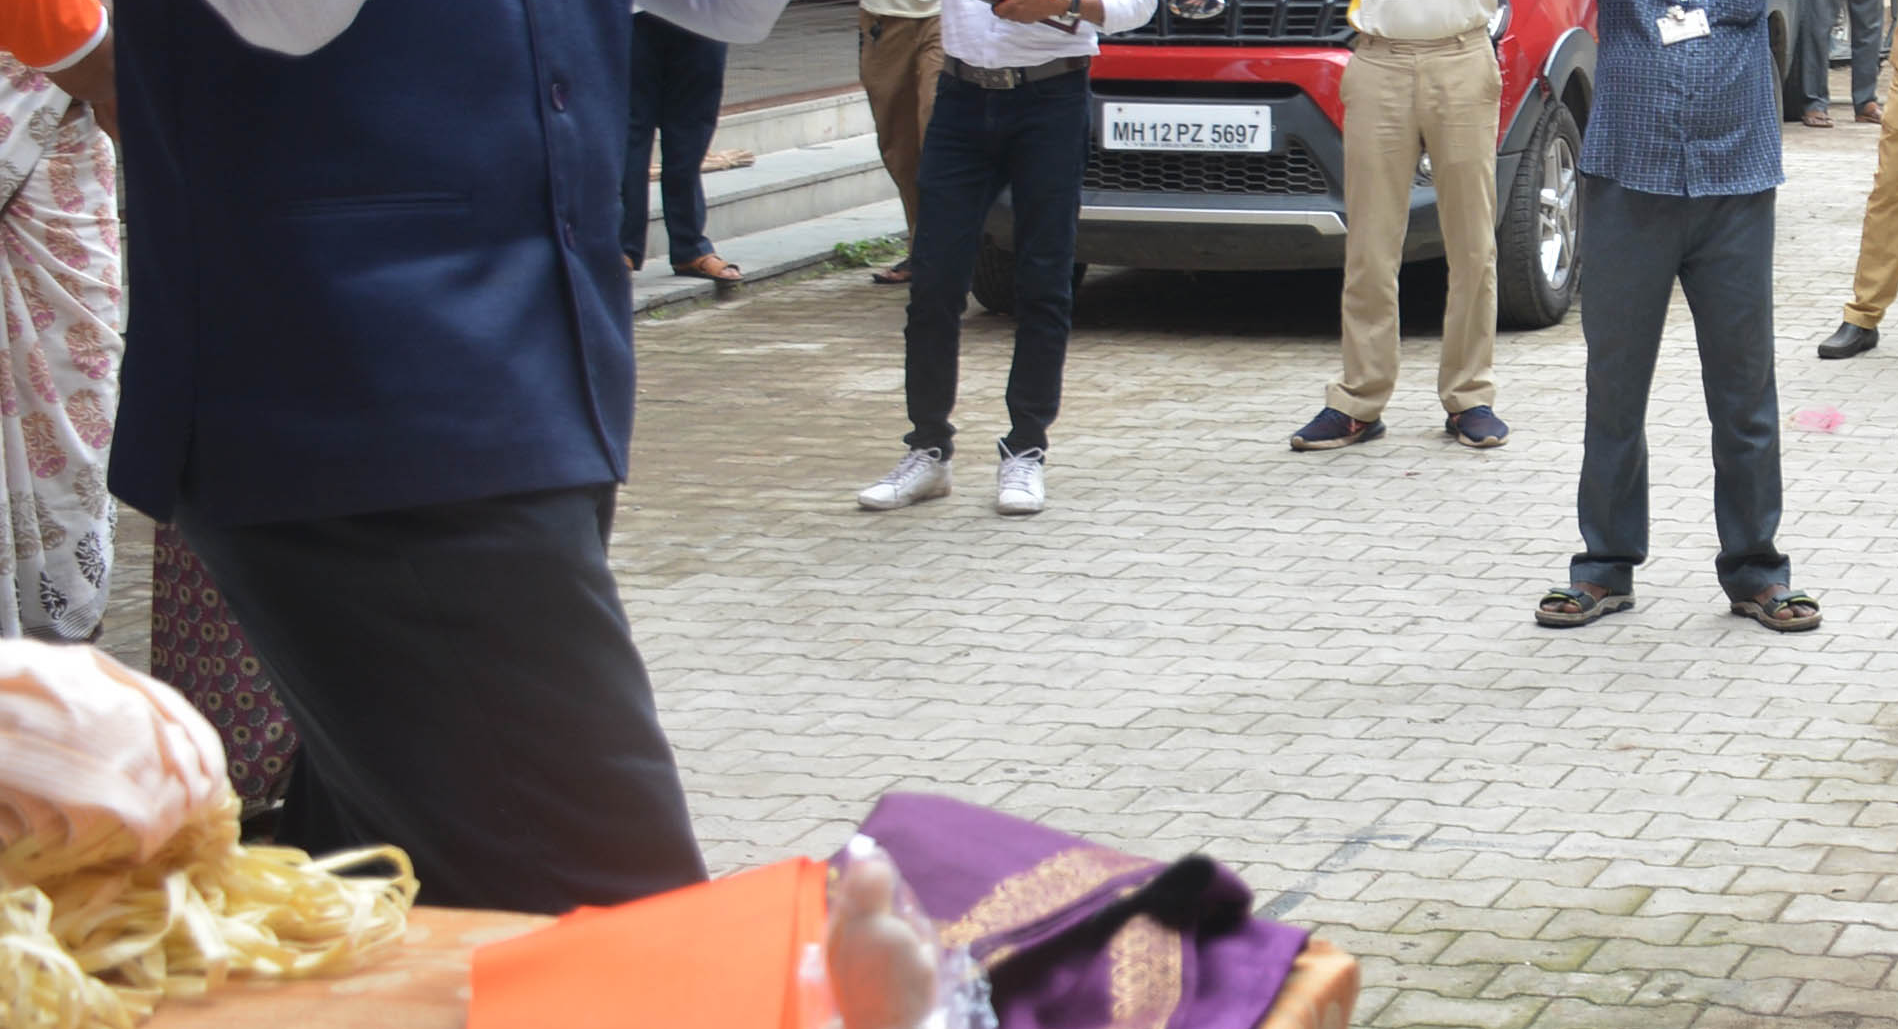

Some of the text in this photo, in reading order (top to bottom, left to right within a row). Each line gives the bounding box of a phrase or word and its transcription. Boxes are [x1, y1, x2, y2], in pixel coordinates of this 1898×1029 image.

[1113, 121, 1260, 144] MH 12 PZ 5697
